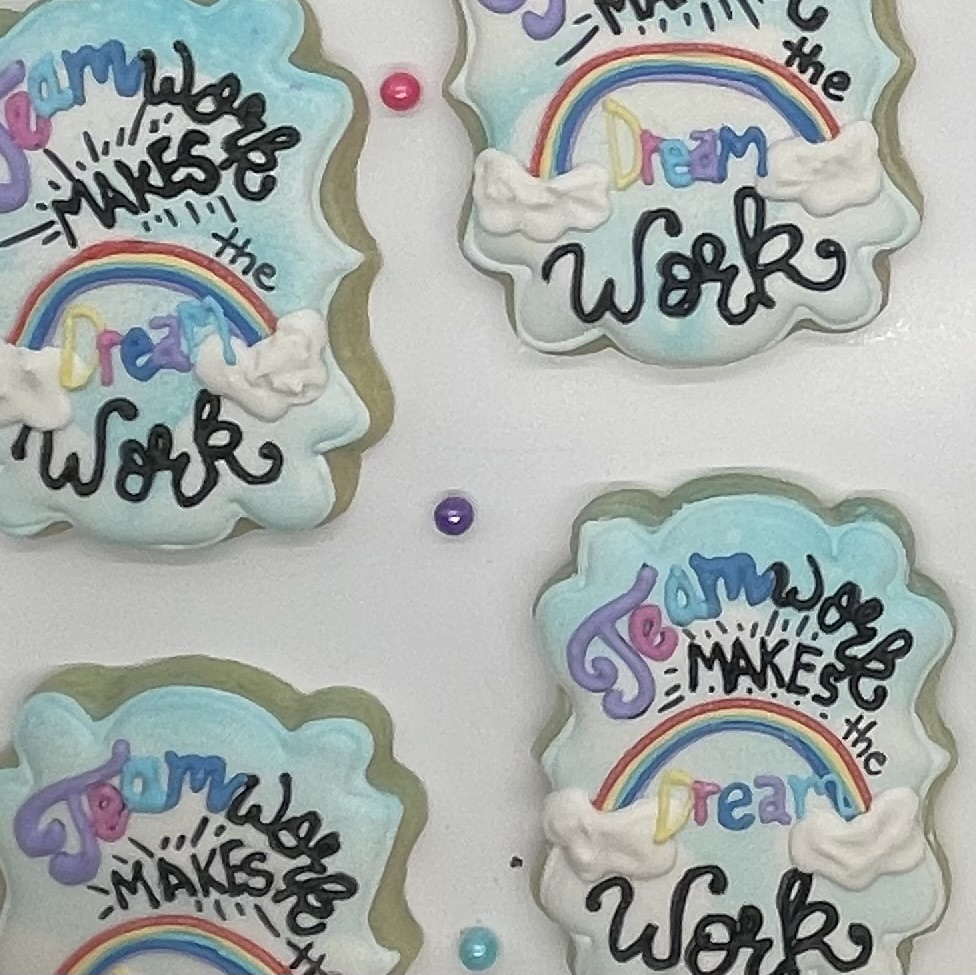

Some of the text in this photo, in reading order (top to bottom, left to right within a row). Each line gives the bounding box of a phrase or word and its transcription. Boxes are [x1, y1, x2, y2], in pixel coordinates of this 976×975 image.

[783, 37, 851, 102] the
[601, 99, 768, 191] Dream
[52, 129, 220, 248] MAKES
[212, 227, 277, 291] the
[542, 186, 845, 324] Work
[59, 295, 237, 390] Dream
[11, 388, 283, 507] Work
[688, 637, 839, 707] MAKES
[842, 715, 887, 776] the
[653, 769, 855, 845] Dream
[111, 839, 274, 911] MAKES
[585, 865, 873, 975] Work
